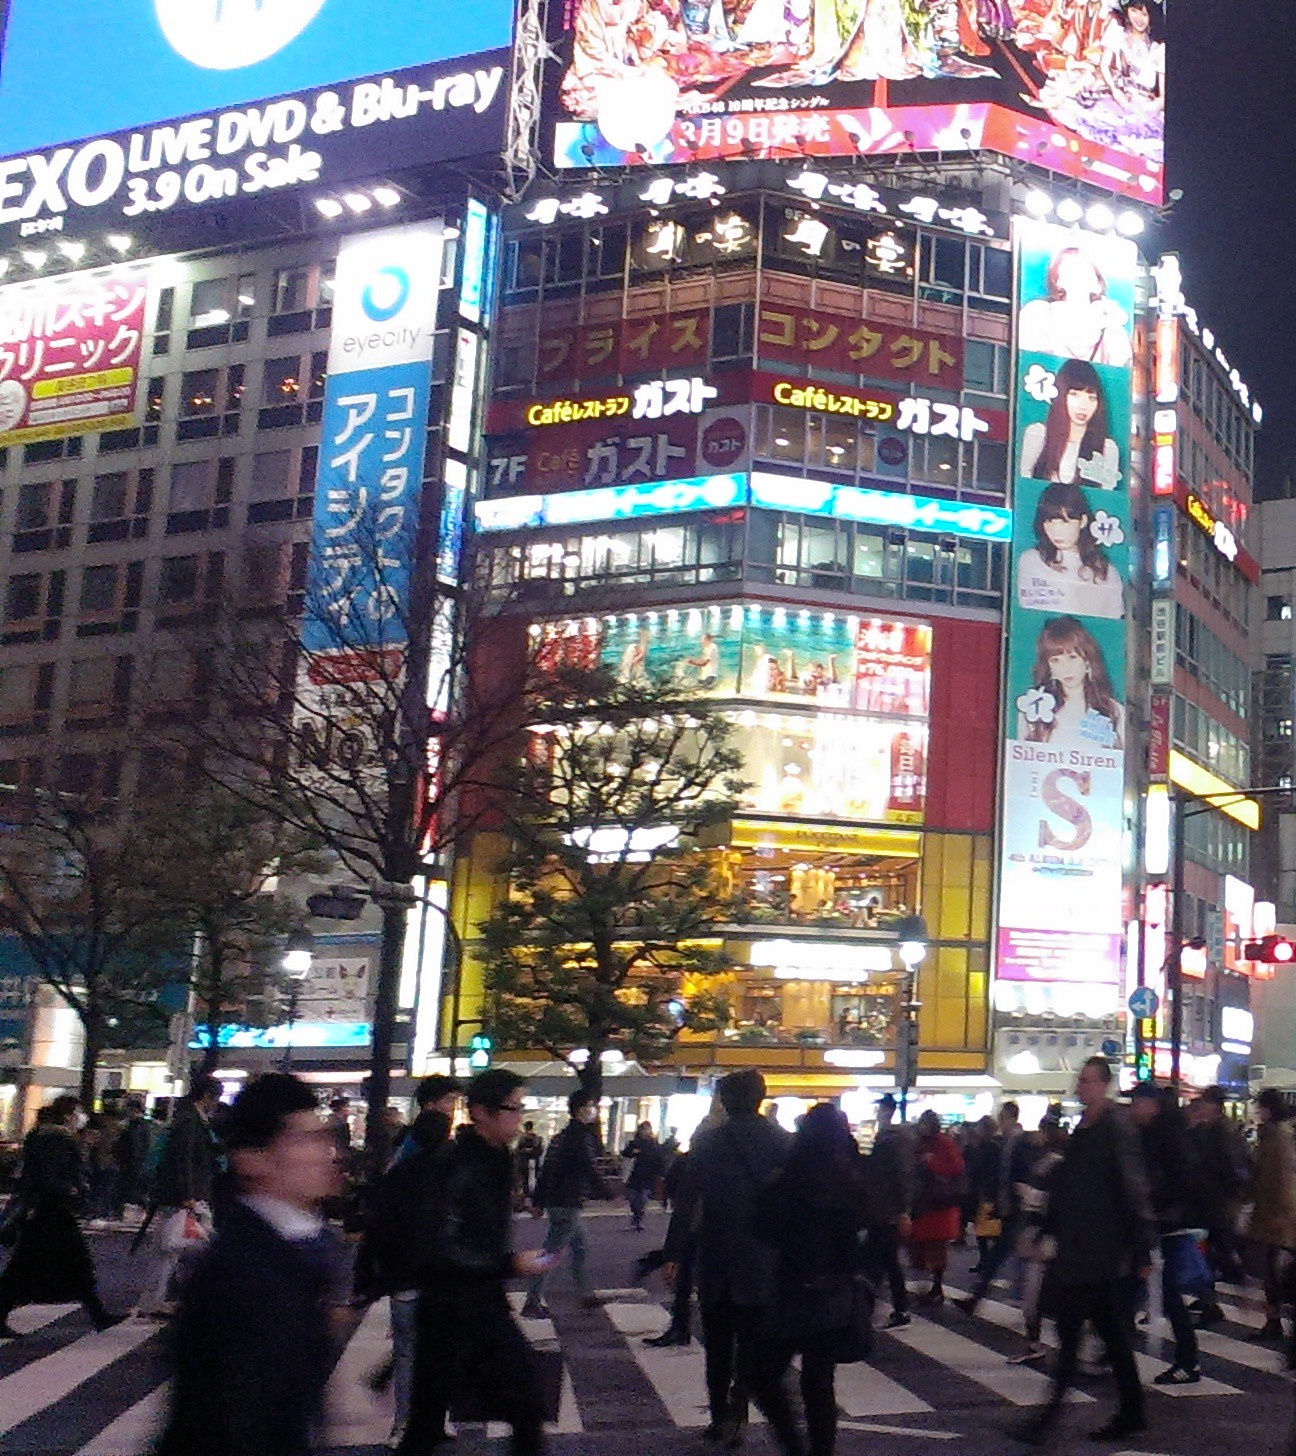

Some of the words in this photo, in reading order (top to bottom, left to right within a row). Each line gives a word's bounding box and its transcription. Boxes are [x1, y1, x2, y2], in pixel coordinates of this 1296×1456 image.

[128, 120, 215, 172] LIVE
[217, 100, 306, 158] DVD
[310, 90, 346, 134] &
[351, 67, 502, 128] Blu-ray
[679, 113, 831, 148] 3月9日発売
[0, 140, 124, 224] EXO
[123, 171, 181, 217] 3.9
[184, 163, 238, 203] On
[242, 144, 323, 192] Sale
[342, 326, 421, 356] eyecity
[760, 308, 957, 374] コンタクト
[632, 378, 718, 421] ガスト
[898, 397, 989, 441] ガスト
[490, 454, 528, 486] 7F
[583, 433, 687, 485] ガスト
[1012, 744, 1065, 765] Silent
[1069, 750, 1118, 768] Siren
[1038, 767, 1093, 851] S
